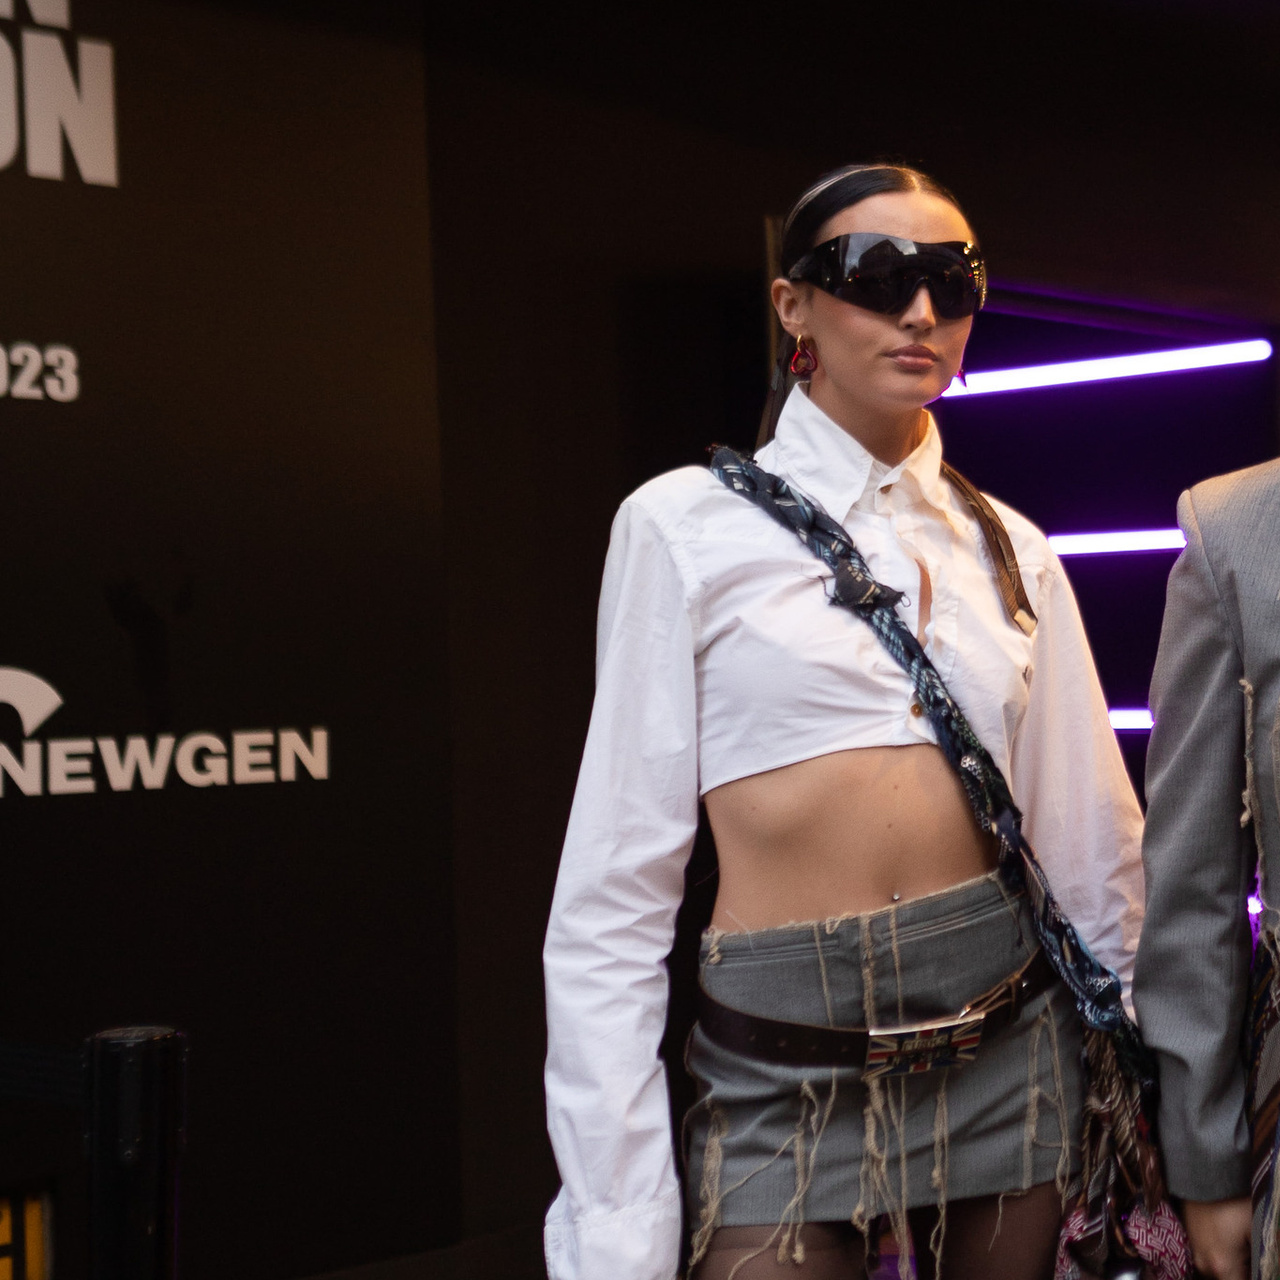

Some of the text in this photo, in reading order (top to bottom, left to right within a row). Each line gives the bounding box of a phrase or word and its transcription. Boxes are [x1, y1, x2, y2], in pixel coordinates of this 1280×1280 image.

[0, 30, 119, 187] N
[0, 341, 80, 403] 23
[0, 727, 329, 797] NEWGEN
